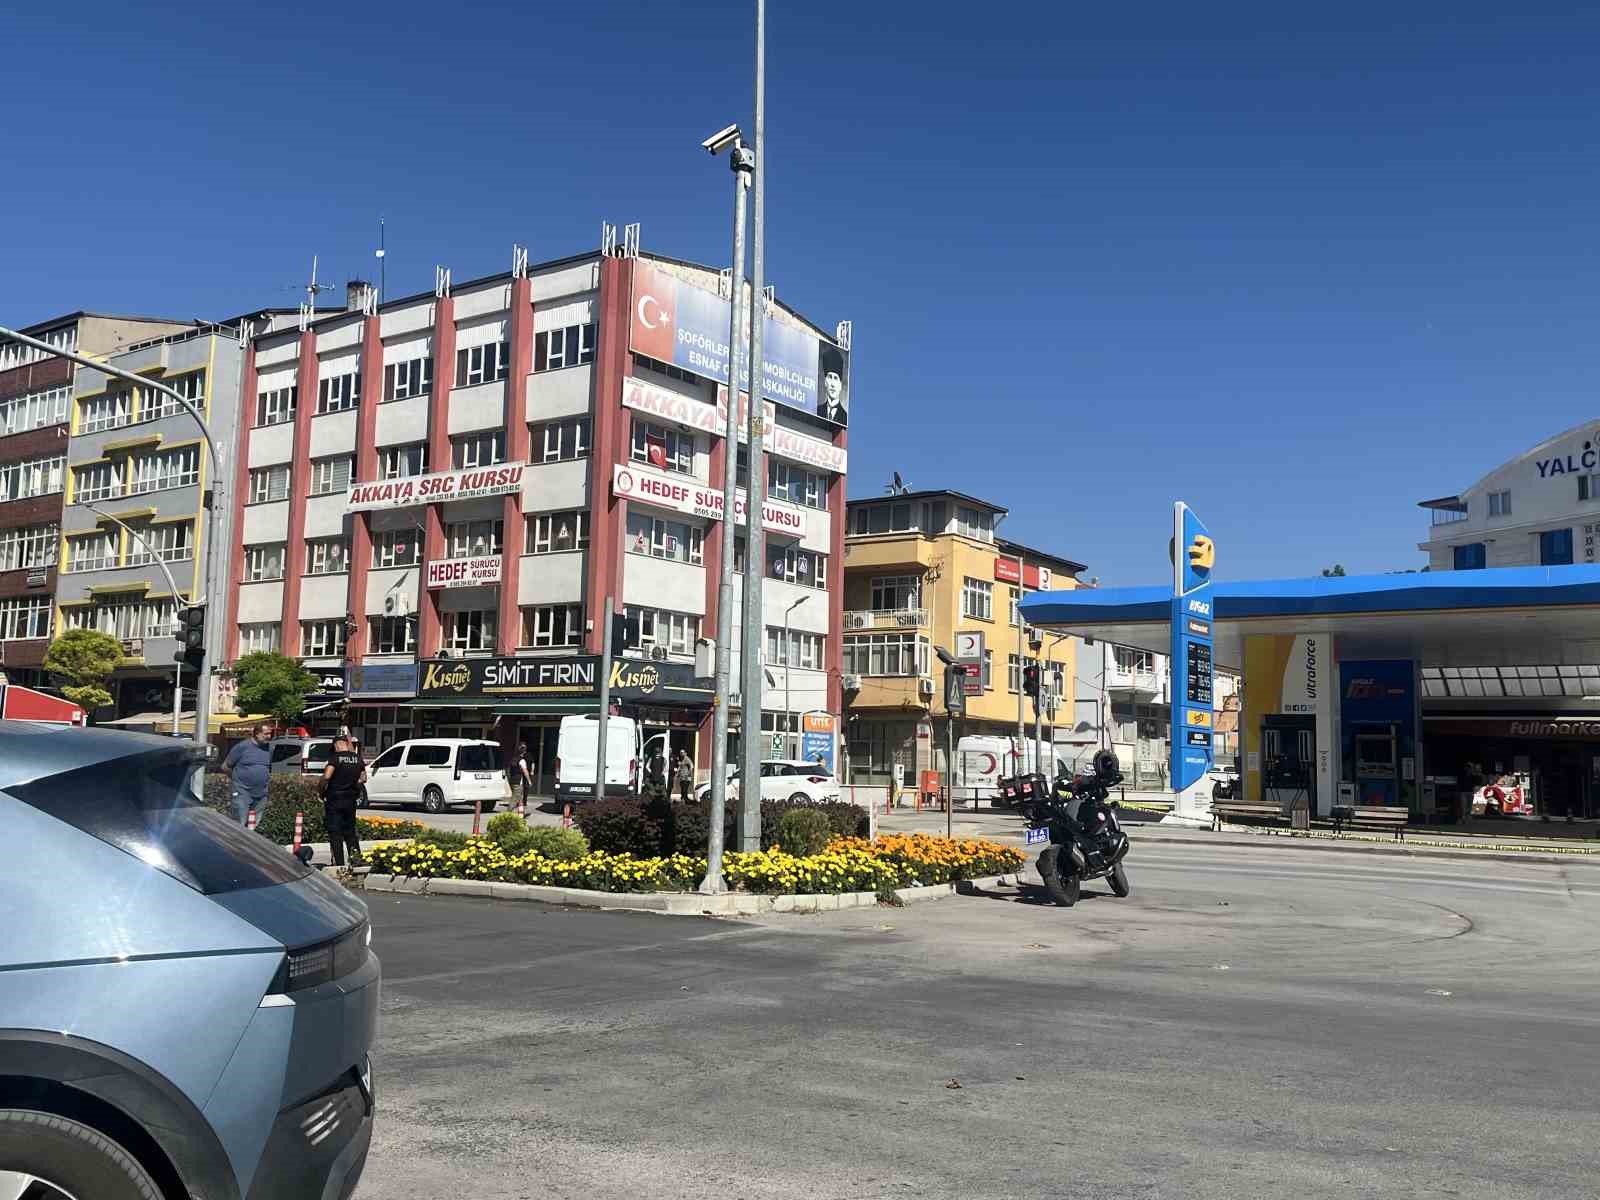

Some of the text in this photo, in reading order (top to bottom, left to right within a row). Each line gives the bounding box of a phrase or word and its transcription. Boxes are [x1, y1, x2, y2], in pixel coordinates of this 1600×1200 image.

[689, 351, 722, 374] ESNAF
[629, 386, 717, 432] AKKAYA
[350, 481, 414, 504] AKKAYA
[418, 475, 455, 497] SRC
[459, 465, 524, 492] KURSU
[640, 478, 690, 503] HEDEF
[430, 561, 468, 582] HEDEF
[471, 568, 497, 579] KURSU
[482, 660, 595, 685] SİMİT FIRINI
[1305, 638, 1316, 699] ultraforce
